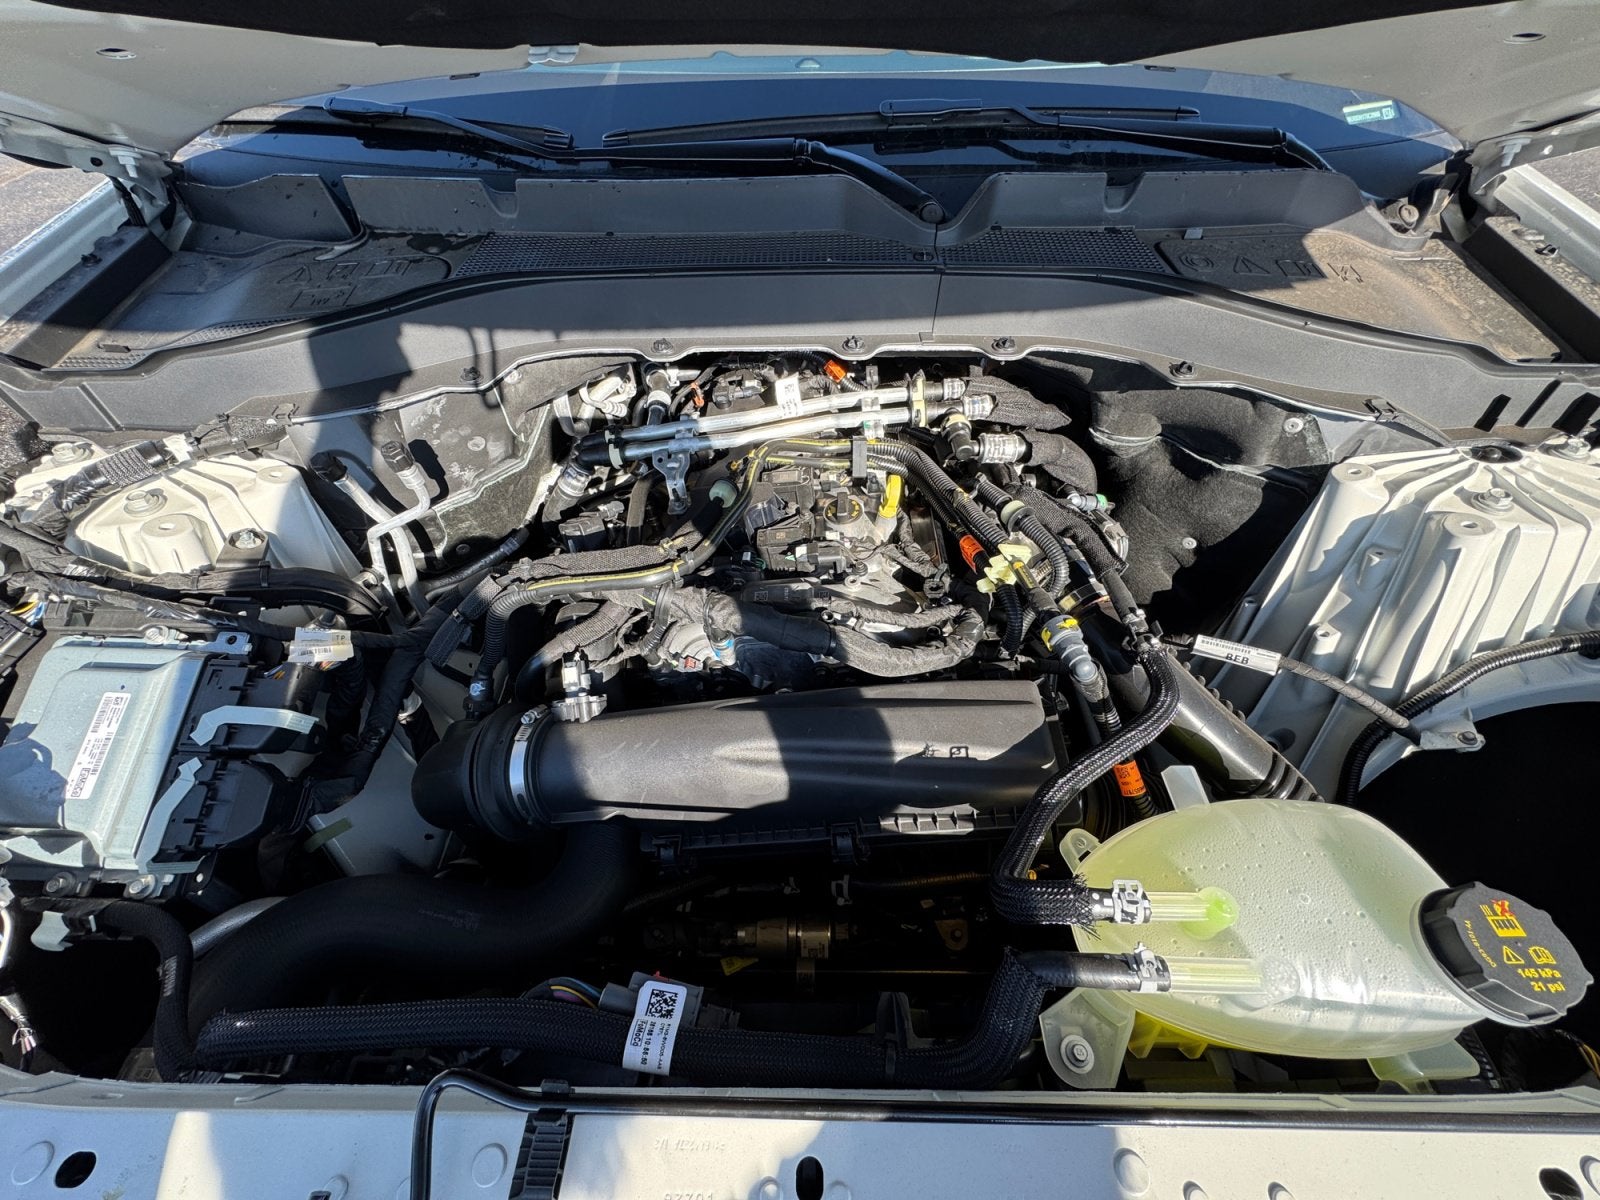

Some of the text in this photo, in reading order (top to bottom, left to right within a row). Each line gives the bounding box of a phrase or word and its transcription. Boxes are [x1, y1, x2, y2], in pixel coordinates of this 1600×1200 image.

[1517, 968, 1562, 978] 145 kPa
[1530, 981, 1566, 993] 21 psi
[633, 1020, 646, 1047] FoMoCo
